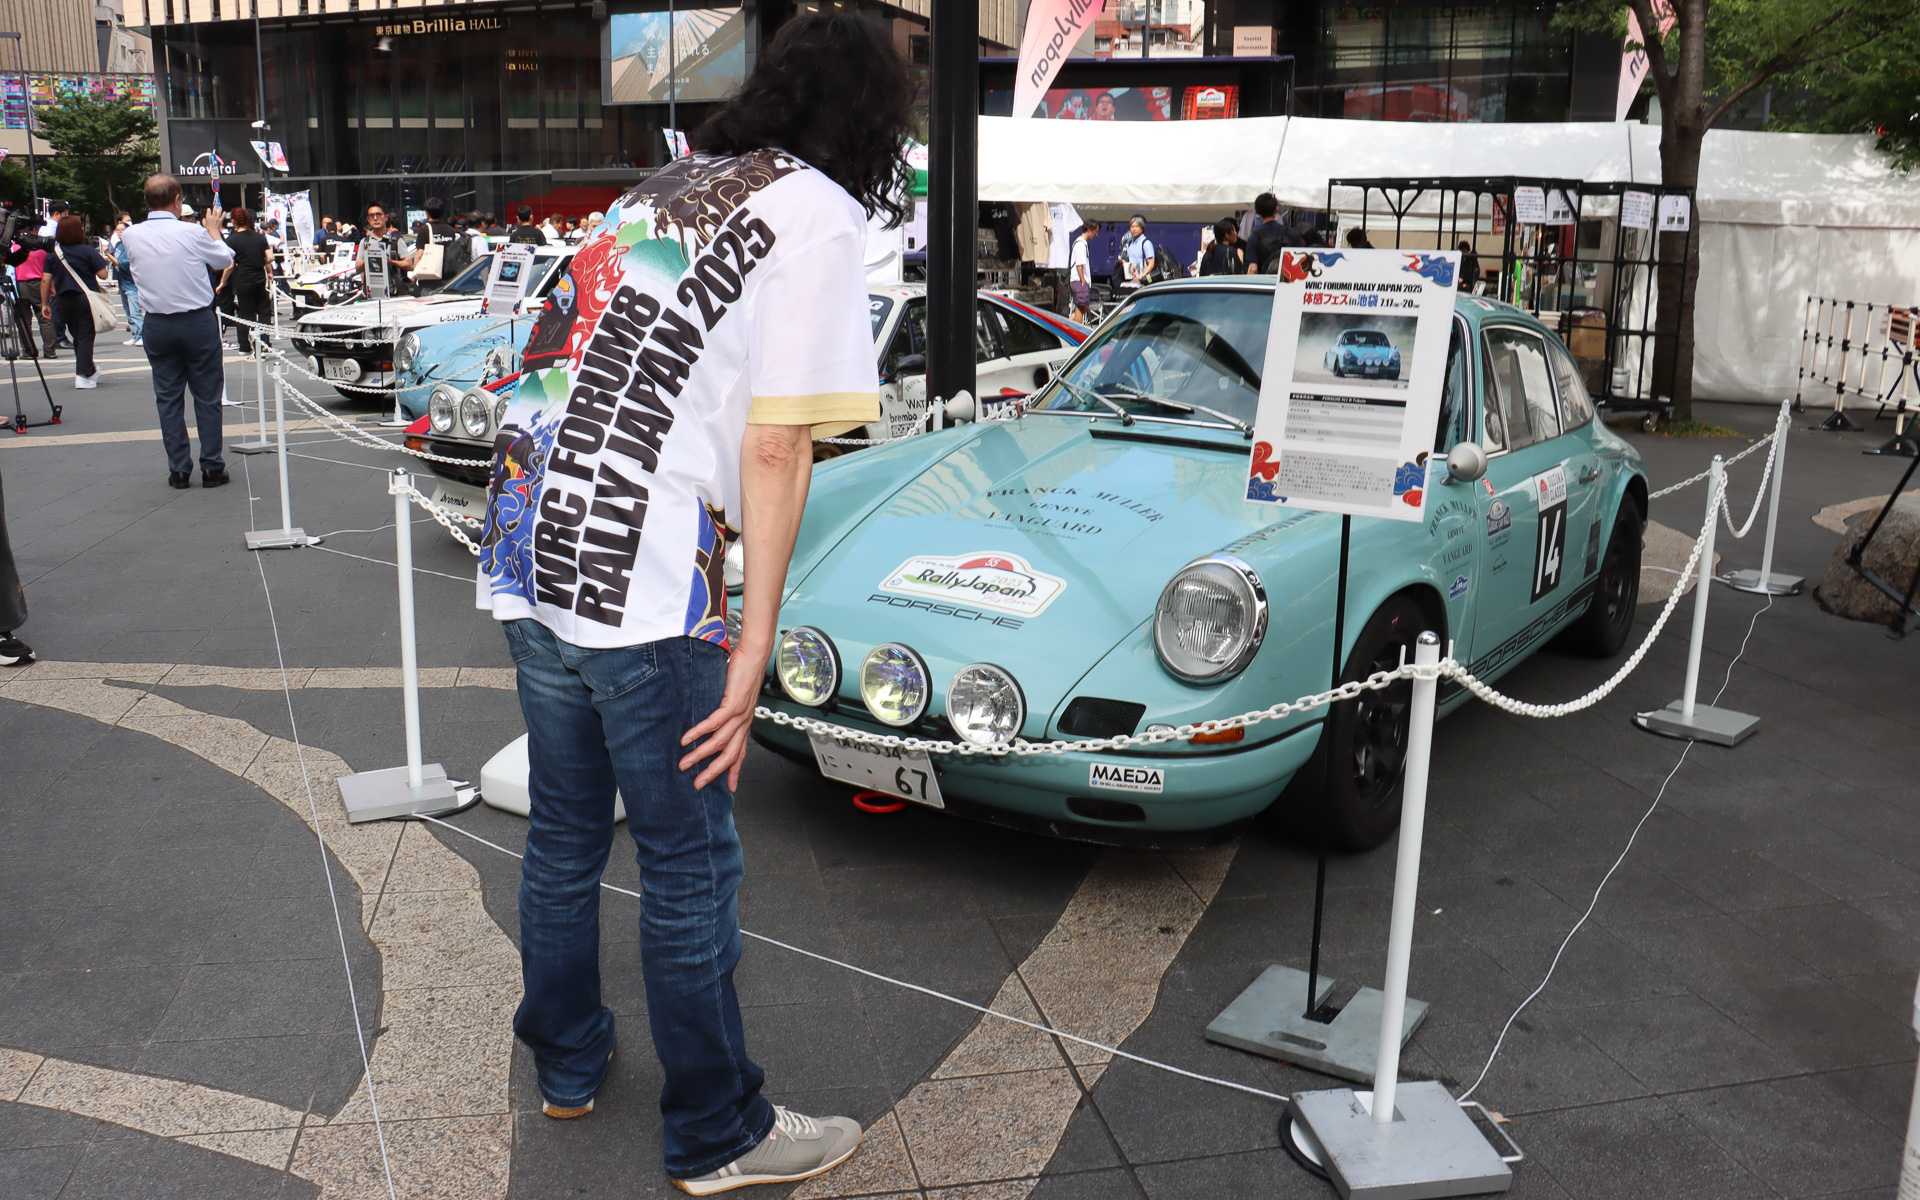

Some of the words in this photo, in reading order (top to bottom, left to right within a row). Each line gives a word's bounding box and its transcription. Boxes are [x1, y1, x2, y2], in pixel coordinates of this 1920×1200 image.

[412, 18, 467, 34] Brillia
[469, 18, 501, 30] HALL
[677, 207, 777, 333] 2025
[1305, 281, 1322, 290] WRC
[1323, 281, 1352, 291] FORUM8
[1353, 282, 1377, 292] RALLY
[1376, 283, 1402, 293] JAPAN
[1403, 284, 1423, 293] 2025
[548, 284, 661, 482] FORUM8
[606, 306, 704, 474] JAPAN
[889, 411, 917, 423] brembo
[440, 493, 469, 508] brembo
[1092, 491, 1165, 523] MULLER
[1550, 484, 1566, 502] CLASSIC
[988, 511, 1103, 535] VANGUARD
[1029, 502, 1096, 516] GENEVE
[536, 487, 588, 610] WRC
[575, 461, 649, 628] RALLY
[1535, 509, 1562, 595] 14
[989, 575, 1022, 587] 2023
[867, 594, 1025, 630] PORSCHE
[1467, 599, 1568, 677] PORSCHE
[1093, 764, 1161, 785] MAEDA
